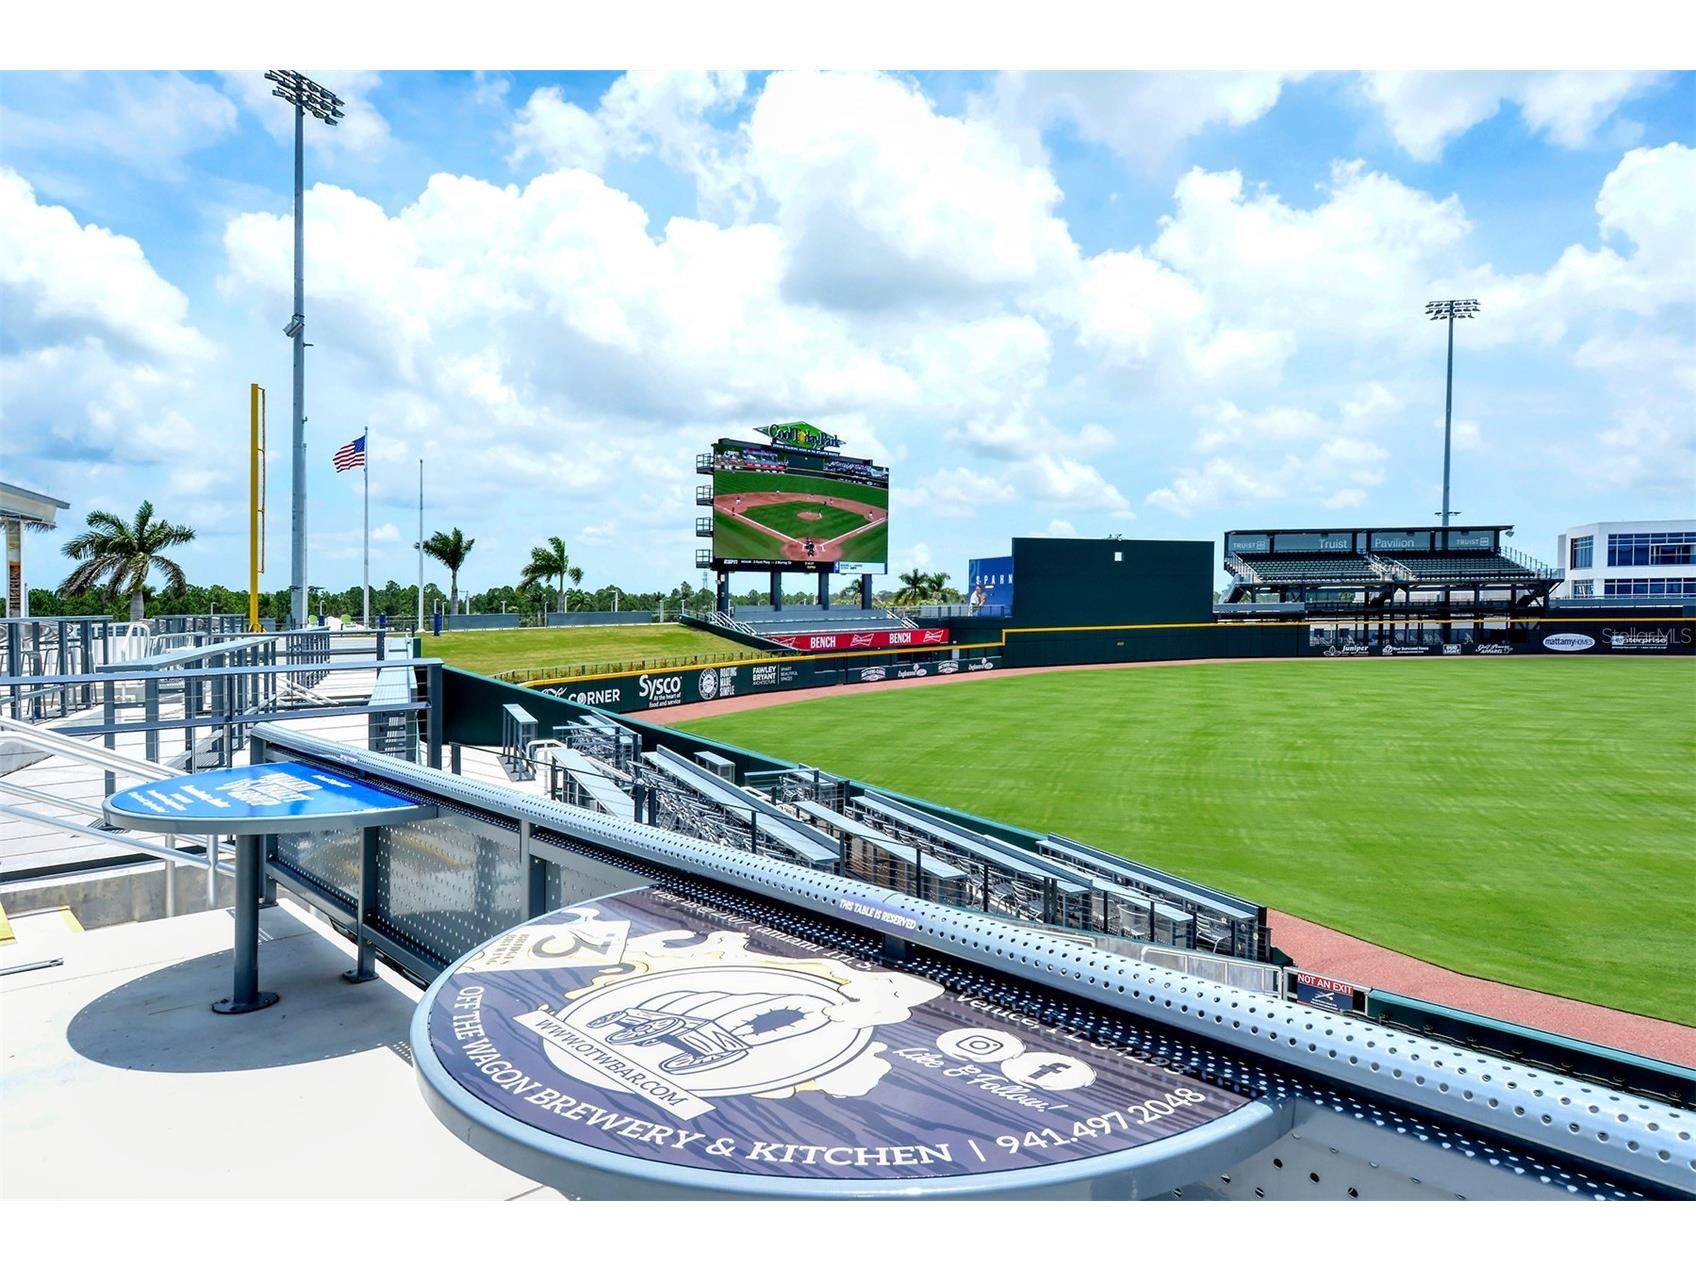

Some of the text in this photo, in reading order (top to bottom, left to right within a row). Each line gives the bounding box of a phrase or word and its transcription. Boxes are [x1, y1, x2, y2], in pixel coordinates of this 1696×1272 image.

[1319, 538, 1415, 549] Truist Pavilion
[810, 636, 836, 648] BENCH
[890, 632, 912, 644] BENCH
[752, 665, 777, 675] FAWLEY
[752, 672, 777, 681] BRYANT
[568, 688, 621, 705] CORNER
[638, 674, 681, 700] Sysco
[840, 899, 917, 930] THIS TABLE IS RESERVED
[748, 925, 825, 952] Tamiami
[1297, 973, 1353, 994] NOT AN EXIT
[955, 992, 1041, 1030] Venice,
[535, 1018, 691, 1107] WWW.OTWBAR.COM
[453, 985, 952, 1166] OFF THE WAGON BREWERY & KITCHEN
[892, 1047, 1069, 1114] Like & Follow!
